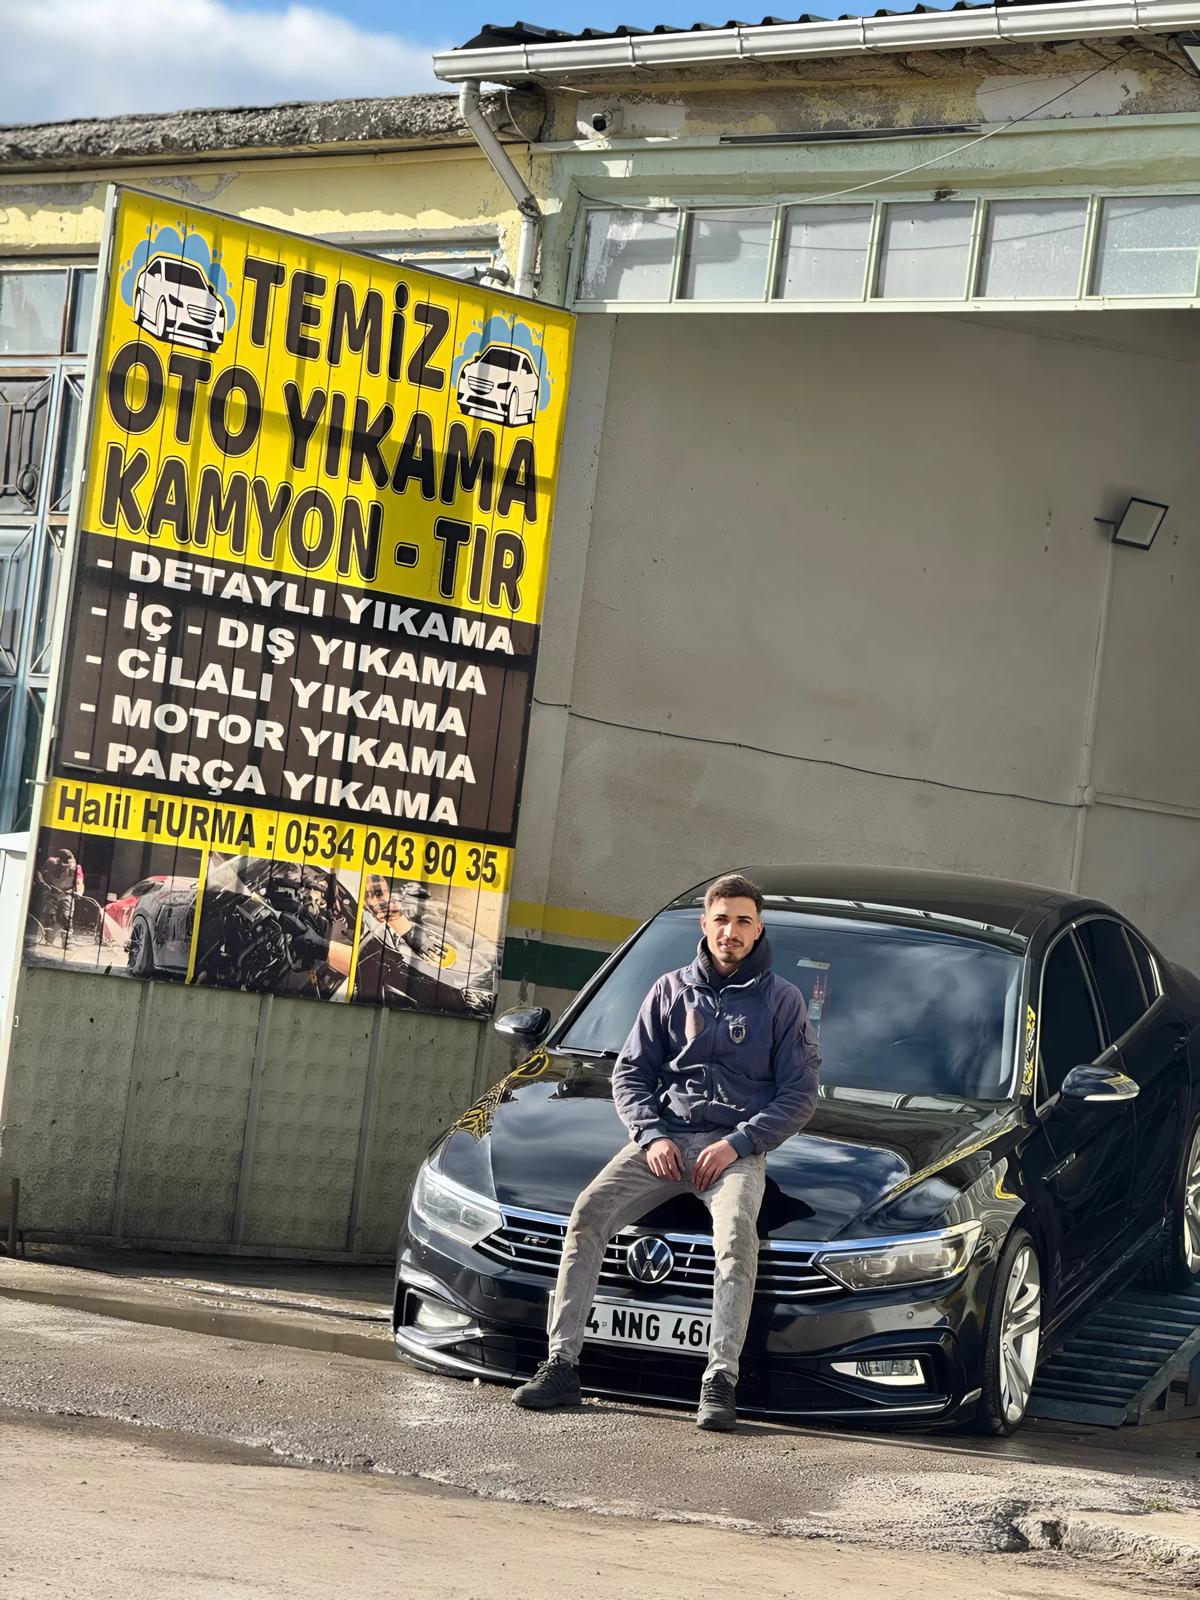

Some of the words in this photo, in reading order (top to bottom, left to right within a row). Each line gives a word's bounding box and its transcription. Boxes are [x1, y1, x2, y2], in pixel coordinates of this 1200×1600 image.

[106, 341, 262, 457] OTO
[283, 382, 538, 524] YIKAMA
[100, 442, 384, 582] KAMYON
[435, 517, 526, 614] TIR
[123, 592, 173, 641] İÇ
[218, 617, 295, 665] DIŞ
[311, 634, 487, 695] YIKAMA
[129, 551, 325, 617] DETAYLI
[341, 593, 514, 655] YIKAMA
[112, 694, 285, 752] MOTOR
[300, 726, 476, 784] YIKAMA
[118, 647, 273, 702] CİLALI
[290, 677, 466, 737] YIKAMA
[106, 742, 266, 796] PARÇA
[283, 770, 458, 826] YIKAMA
[58, 785, 131, 830] Halil
[141, 798, 255, 848] HURMA
[285, 820, 354, 862] 0534
[364, 832, 415, 872] 043
[424, 841, 457, 877] 90
[465, 848, 497, 883] 35
[584, 1307, 600, 1334] 4
[611, 1309, 660, 1341] NNG
